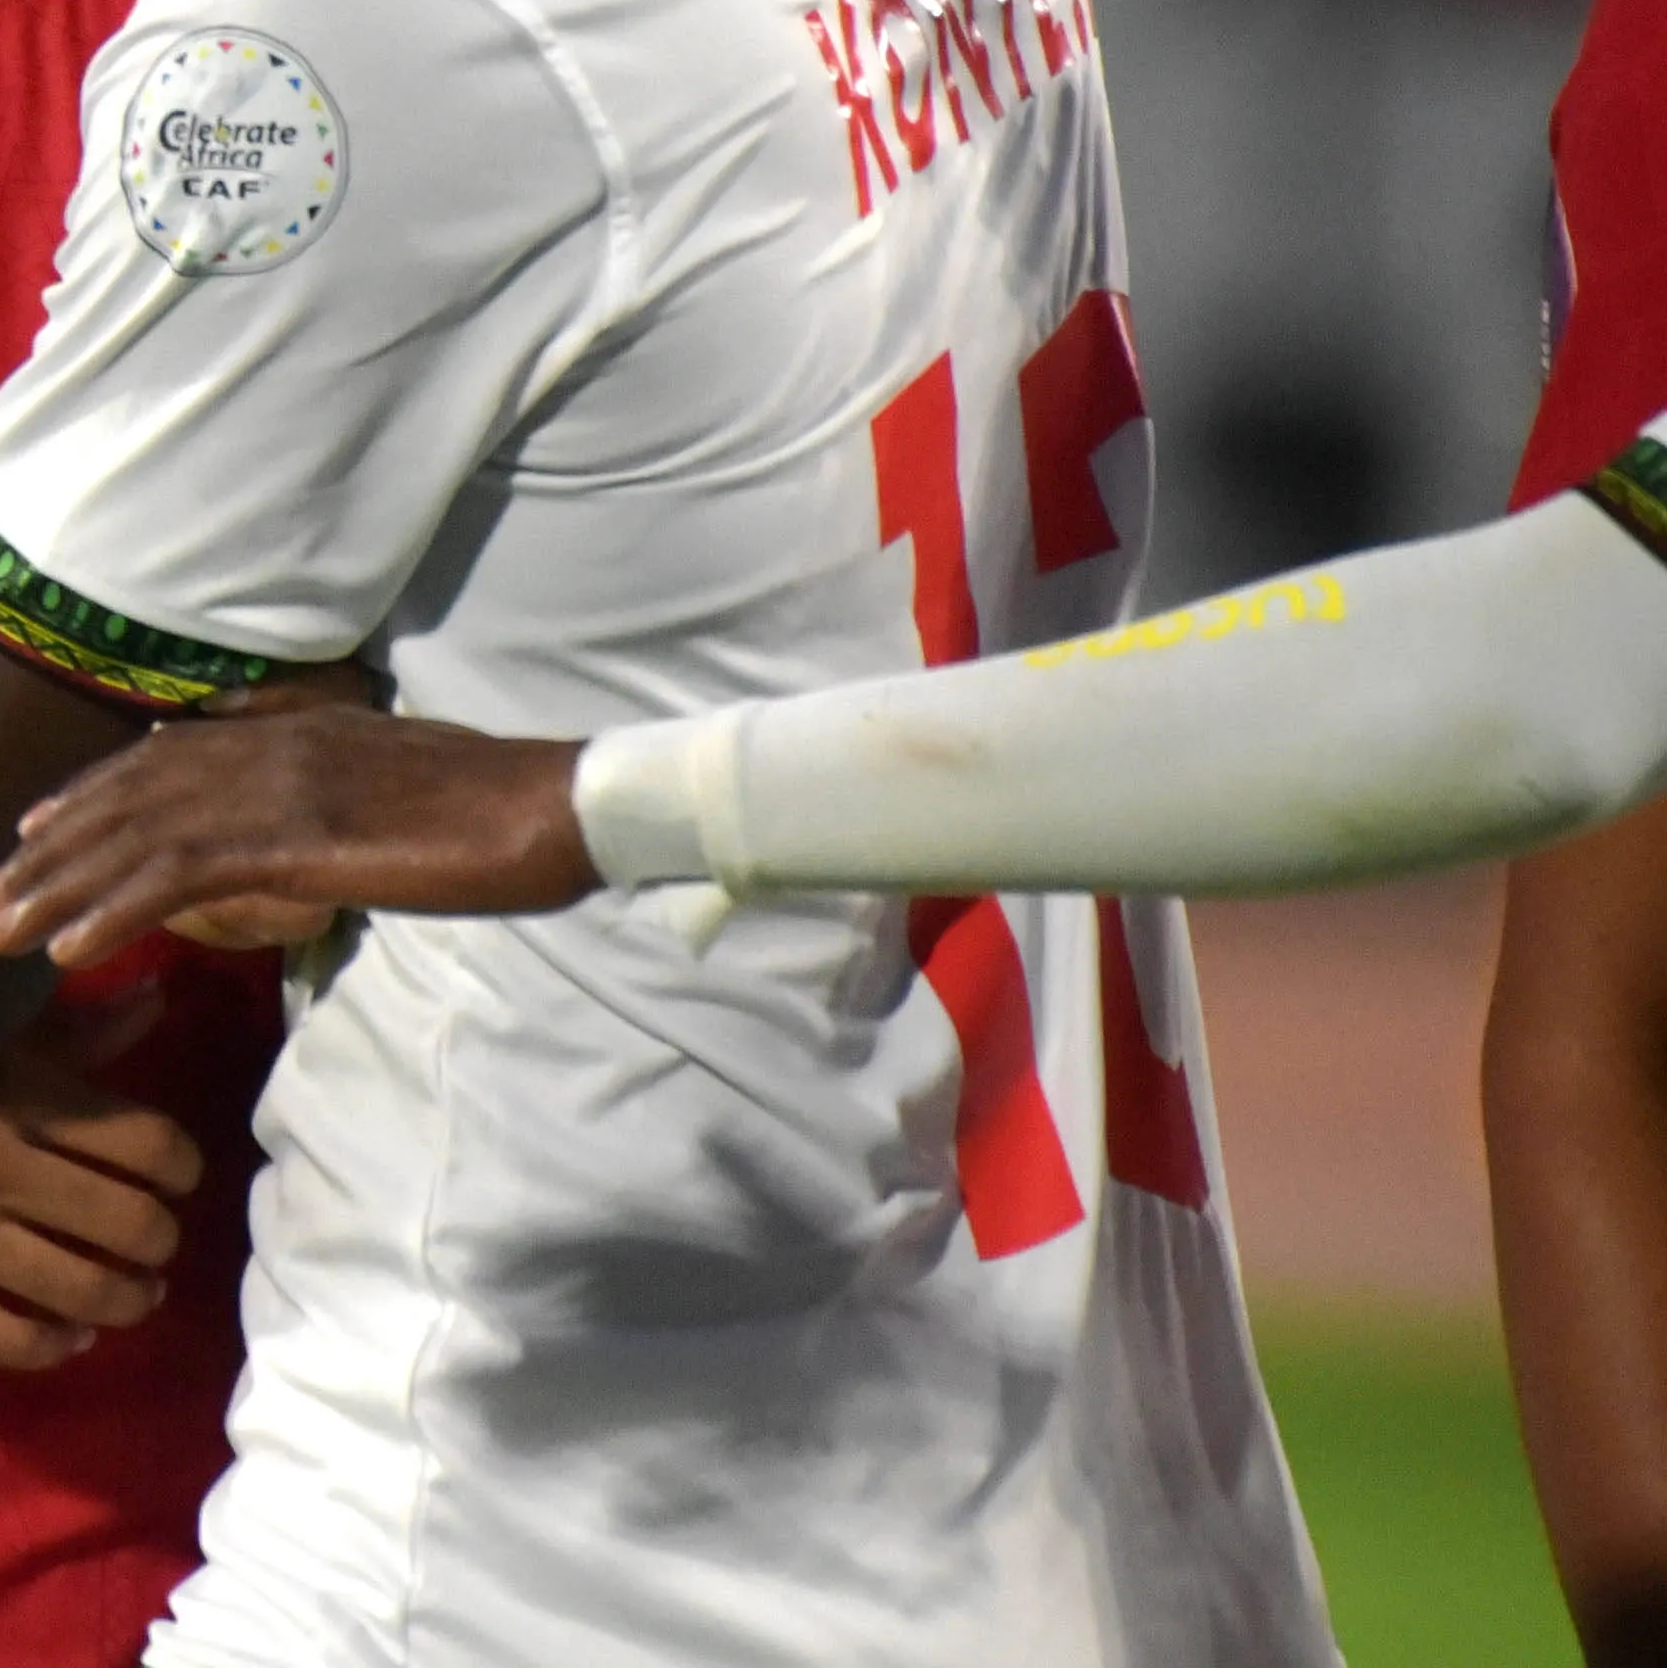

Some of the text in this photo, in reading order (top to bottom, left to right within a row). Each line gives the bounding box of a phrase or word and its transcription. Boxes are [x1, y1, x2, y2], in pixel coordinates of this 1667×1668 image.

[159, 110, 299, 152] Celebrate
[178, 148, 264, 169] Africa
[182, 177, 262, 200] CAF
